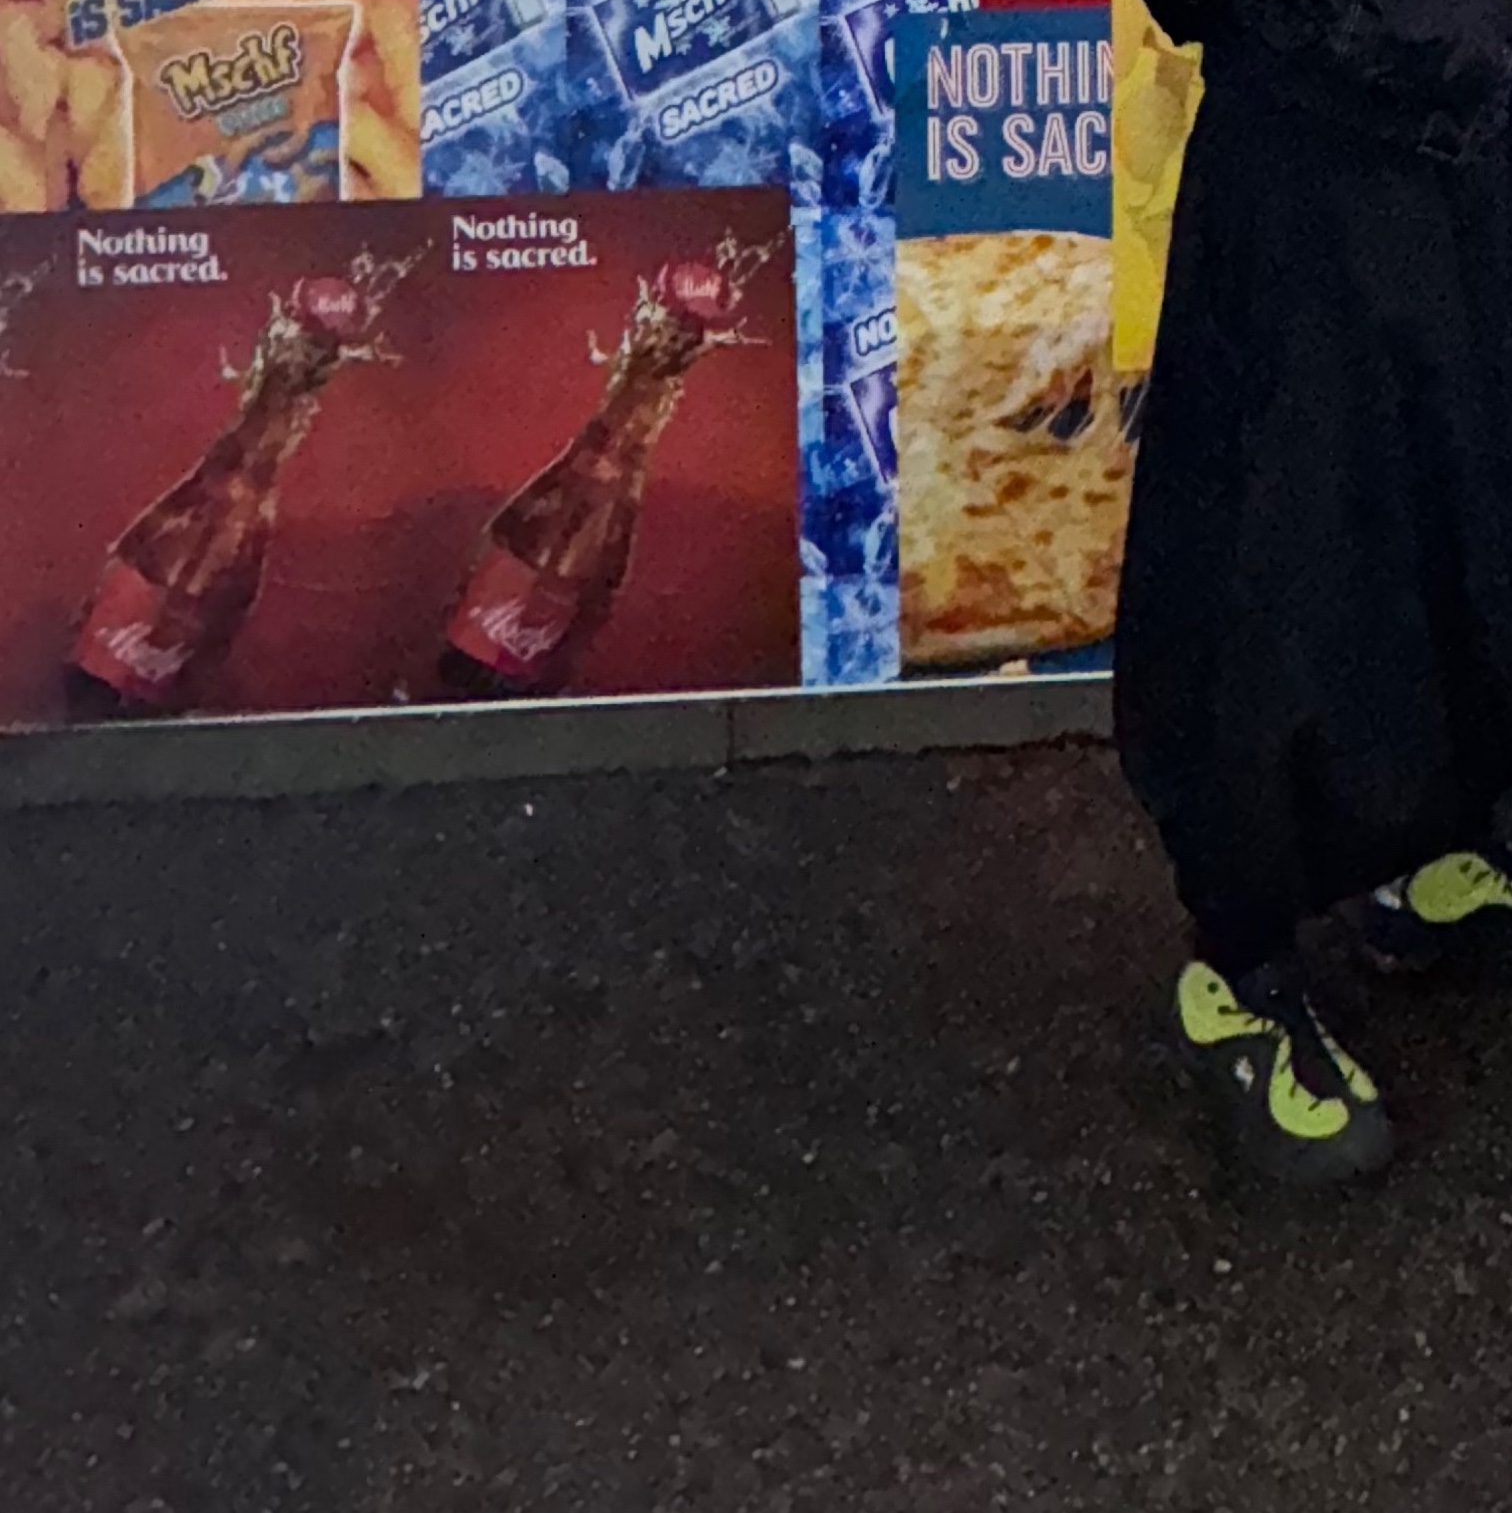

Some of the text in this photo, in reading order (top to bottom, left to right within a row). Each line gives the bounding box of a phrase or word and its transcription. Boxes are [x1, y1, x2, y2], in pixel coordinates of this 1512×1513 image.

[158, 23, 301, 121] Mschf
[660, 59, 780, 140] SACRED
[927, 112, 980, 180] IS
[77, 227, 210, 257] Nothing
[452, 212, 579, 245] Nothing
[78, 255, 229, 286] is sacred.
[452, 239, 598, 272] is sacred.
